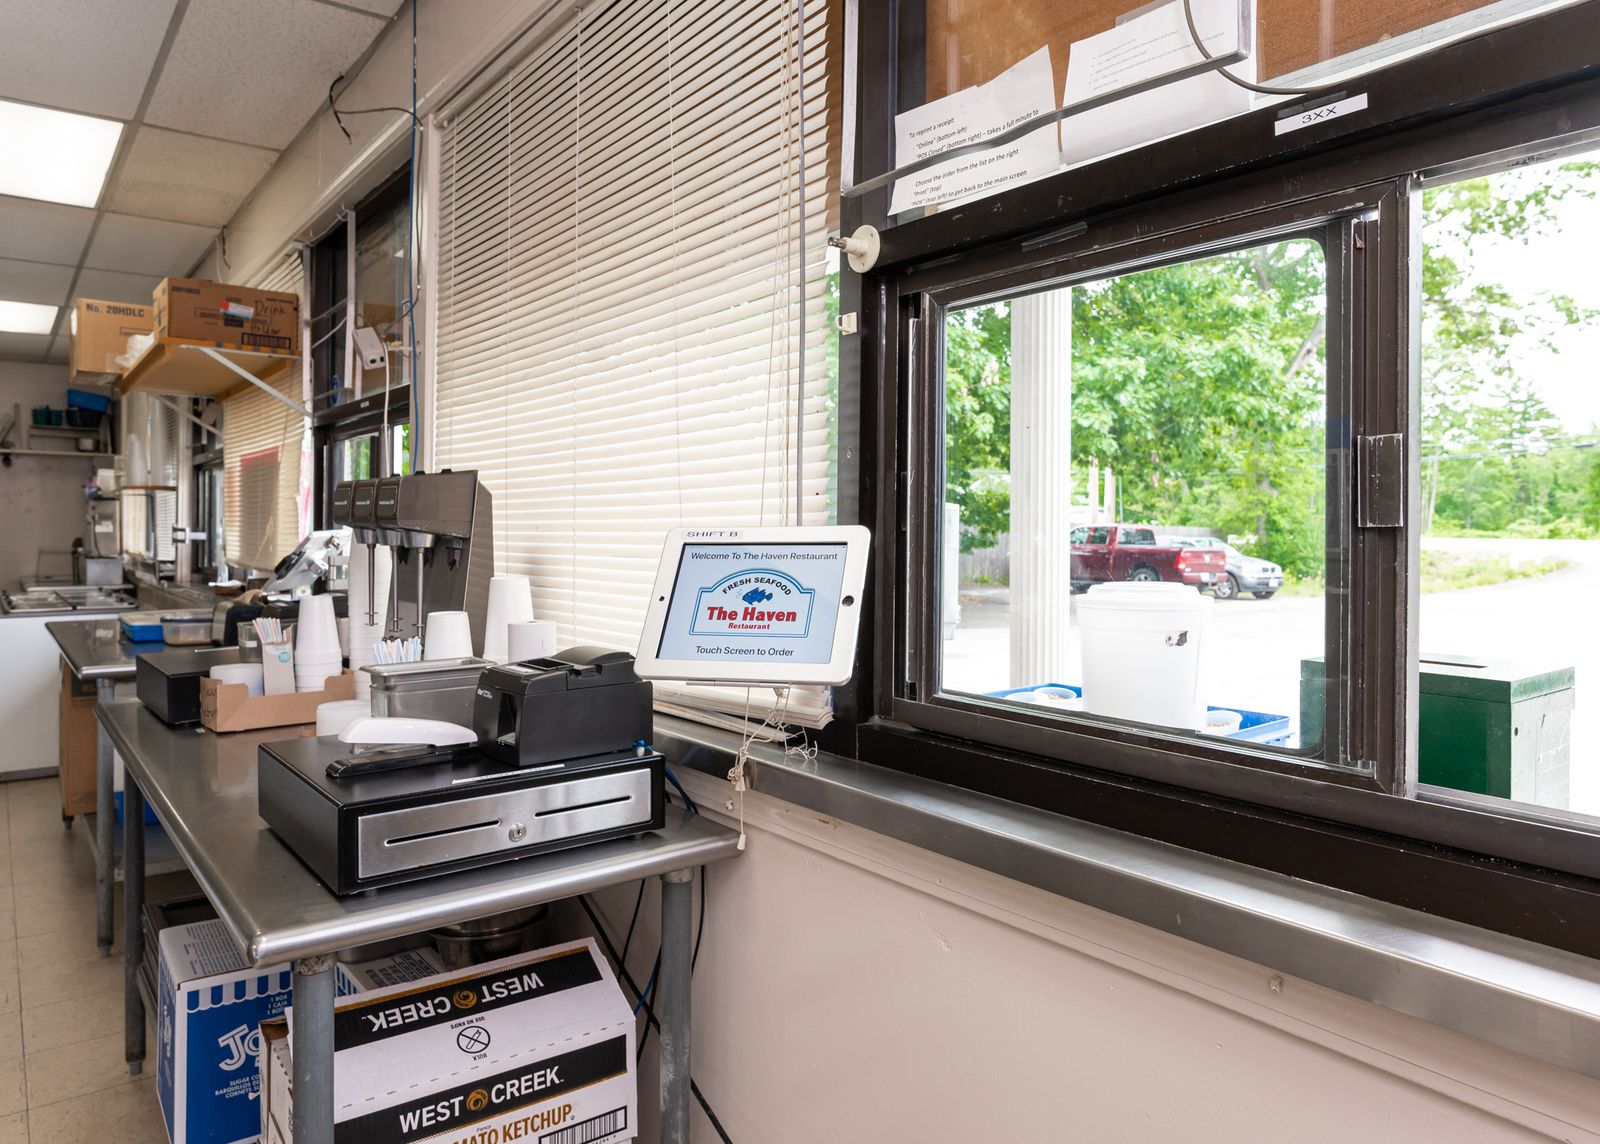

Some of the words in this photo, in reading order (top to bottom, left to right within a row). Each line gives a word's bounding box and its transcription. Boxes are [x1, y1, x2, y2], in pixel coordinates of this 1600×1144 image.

[1302, 106, 1336, 124] 3XX
[916, 126, 932, 136] reprint
[937, 131, 956, 143] (bottom
[957, 126, 968, 134] left)
[947, 138, 966, 150] (bottom
[968, 132, 982, 142] right)
[1015, 112, 1032, 123] minute
[916, 177, 932, 187] Choose
[942, 170, 956, 178] order
[1006, 149, 1019, 158] right
[954, 188, 963, 196] get
[1009, 170, 1027, 179] screen
[255, 300, 287, 316] Drink
[691, 552, 730, 560] Welcome
[722, 578, 751, 594] FRESH
[754, 577, 792, 595] SEAFOOD
[707, 606, 738, 620] The
[742, 607, 797, 622] Haven
[696, 646, 722, 654] Touch
[724, 647, 755, 655] Screen
[768, 648, 794, 656] Order
[481, 972, 544, 1003] WEST
[367, 996, 451, 1032] CREEK
[450, 1021, 466, 1029] KNIFE
[218, 1024, 260, 1071] JO
[473, 1053, 487, 1061] BULK
[215, 1082, 251, 1096] BARQUILLOS
[230, 1076, 250, 1086] SUGAR
[399, 1095, 464, 1134] WEST
[490, 1065, 560, 1104] CREEK
[502, 1103, 572, 1143] KETCHUP
